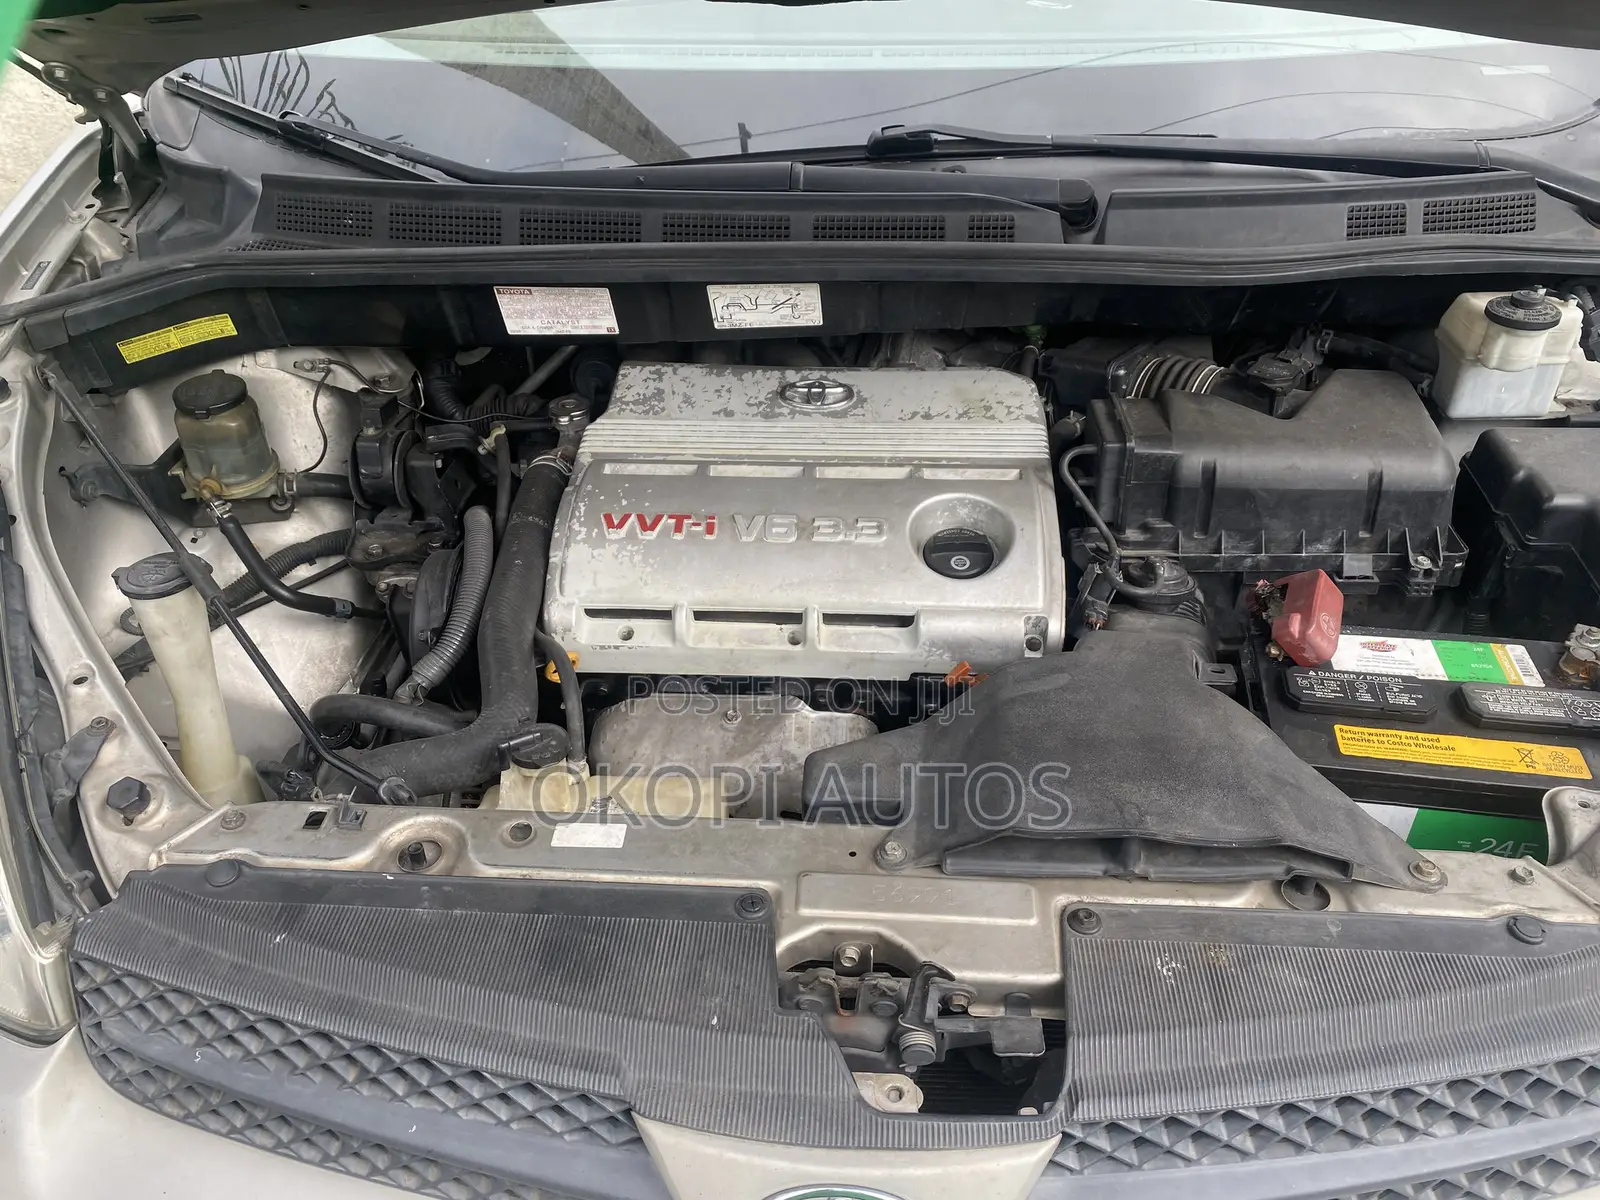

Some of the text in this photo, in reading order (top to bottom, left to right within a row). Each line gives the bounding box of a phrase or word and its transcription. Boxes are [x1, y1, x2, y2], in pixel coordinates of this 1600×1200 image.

[601, 512, 888, 543] VVT-i V6 3.3
[1359, 641, 1398, 649] INTERSTATE
[1318, 671, 1357, 680] DANGER
[1366, 675, 1402, 683] POISON
[1339, 727, 1441, 744] Return warranty and used
[1341, 735, 1376, 744] batteries
[1387, 740, 1413, 748] Costco
[1413, 742, 1456, 752] Wholesale
